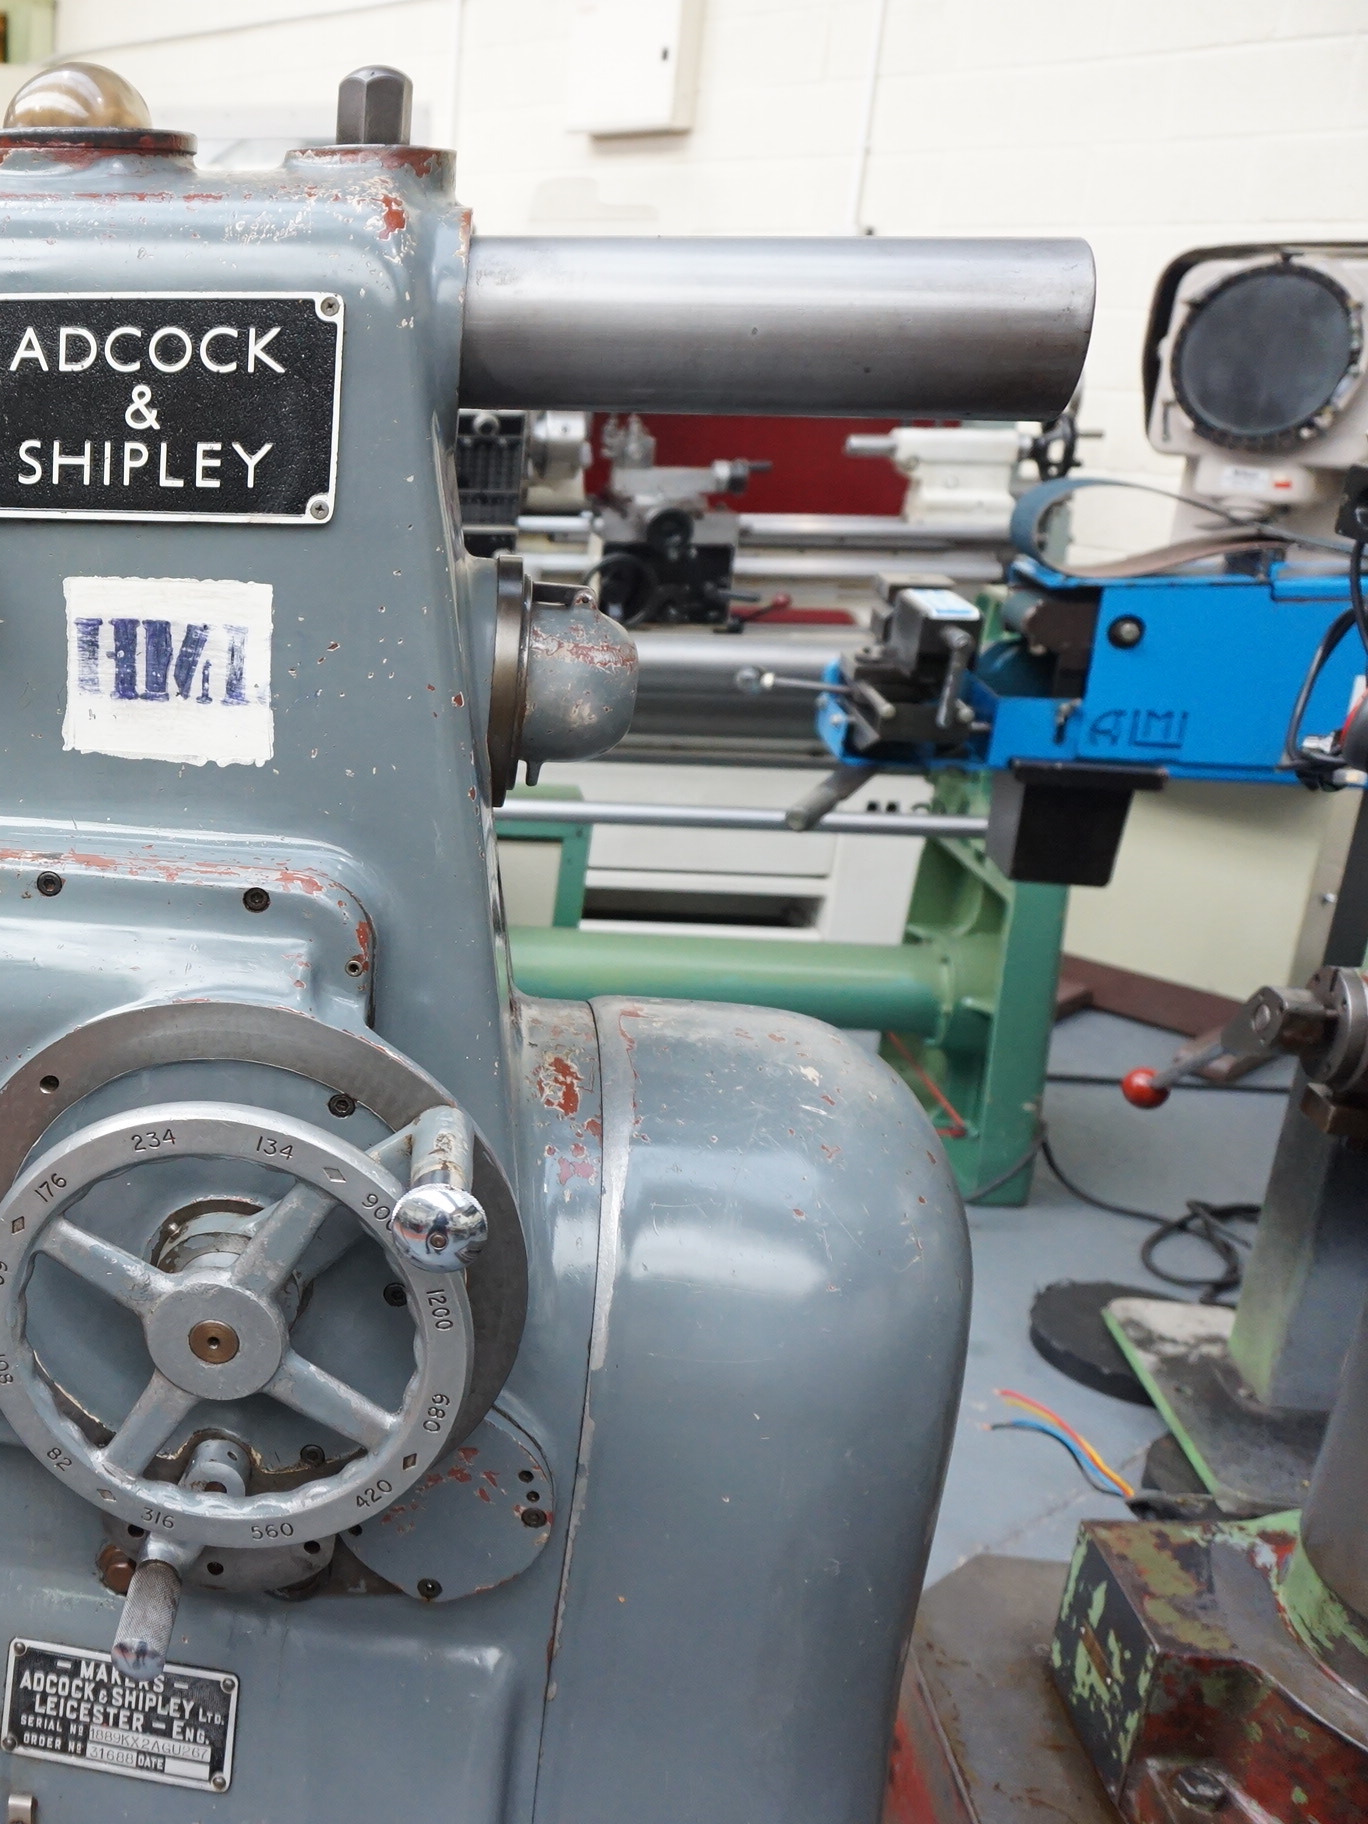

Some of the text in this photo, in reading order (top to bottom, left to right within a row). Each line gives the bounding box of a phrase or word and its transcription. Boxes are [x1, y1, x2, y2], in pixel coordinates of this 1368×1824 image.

[9, 326, 286, 373] ADCOCK
[124, 384, 161, 430] &
[18, 440, 274, 489] SHIPLEY
[131, 1129, 176, 1153] 234
[256, 1135, 294, 1160] 134
[34, 1173, 67, 1203] 176
[426, 1289, 453, 1331] 1200
[422, 1393, 450, 1433] 680
[47, 1447, 72, 1472] 82
[356, 1479, 393, 1508] 420
[141, 1506, 174, 1530] 316
[250, 1522, 294, 1541] 560
[19, 1669, 95, 1702] ADCOCK
[98, 1688, 108, 1704] &
[112, 1686, 194, 1720] SHIPLEY
[20, 1713, 63, 1733] SERIAL
[34, 1692, 145, 1733] LEICESTER
[23, 1730, 62, 1751] ORDER
[89, 1745, 134, 1765] 31688
[136, 1753, 165, 1770] DATE
